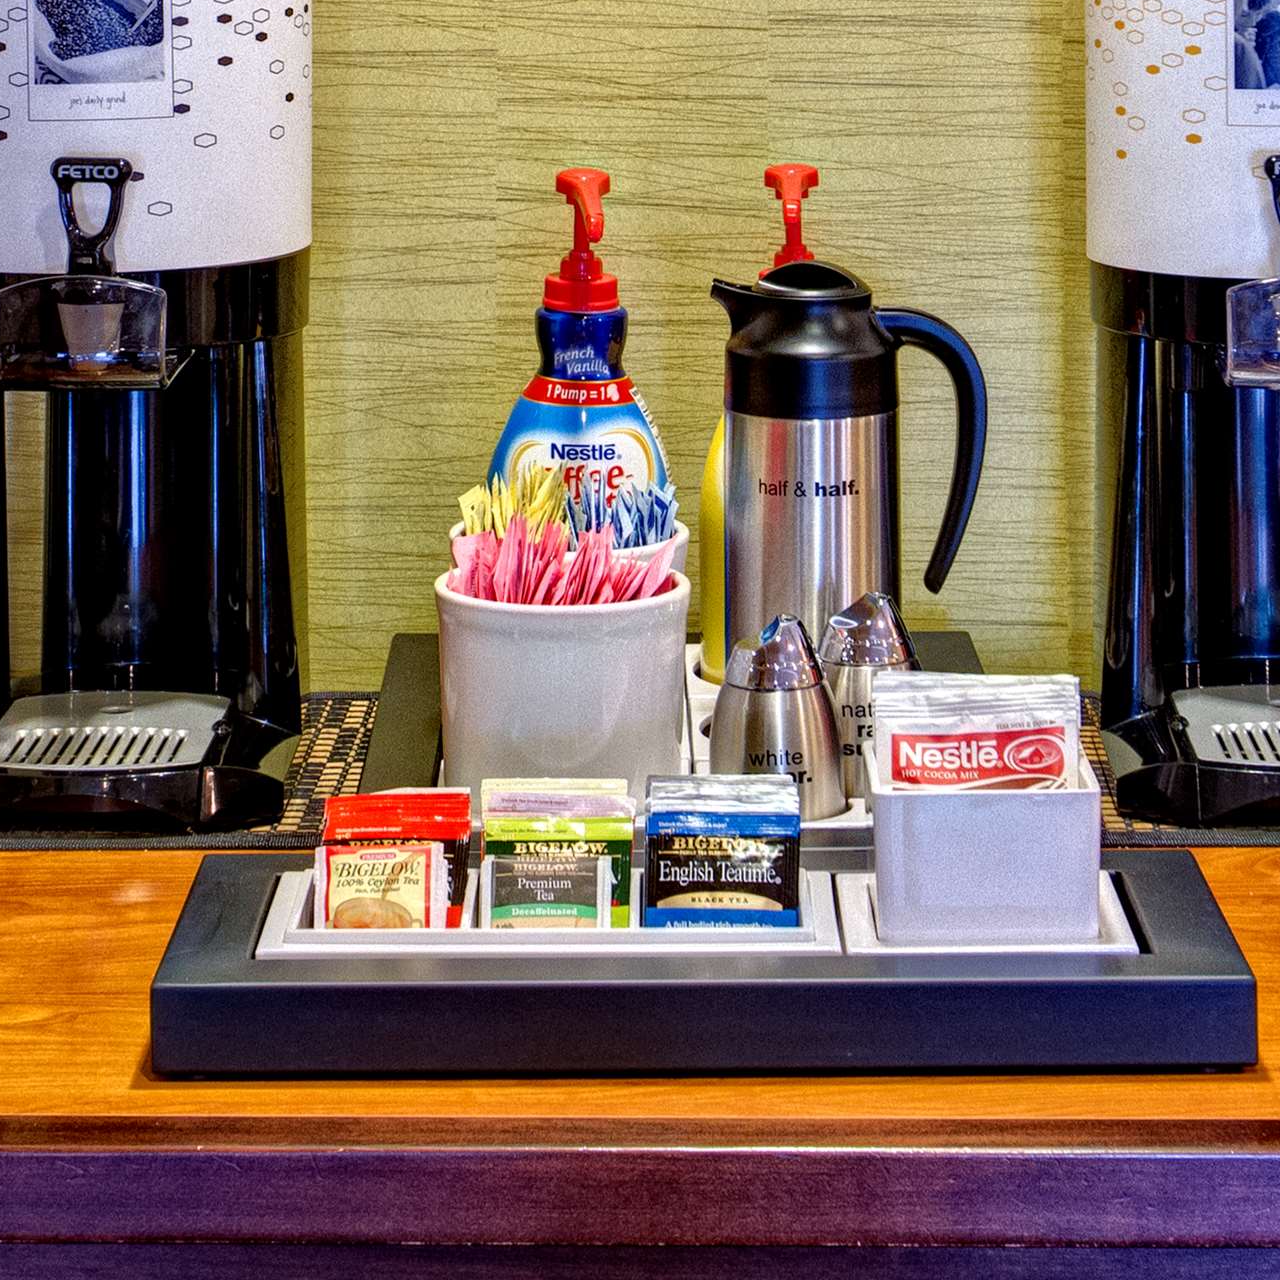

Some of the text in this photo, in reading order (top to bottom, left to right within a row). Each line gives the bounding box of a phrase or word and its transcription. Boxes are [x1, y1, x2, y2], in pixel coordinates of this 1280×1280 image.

[57, 164, 119, 180] FETCO
[554, 345, 595, 365] French
[566, 359, 610, 376] Vanilla
[546, 384, 553, 397] 1
[553, 384, 588, 403] Pump
[759, 478, 860, 498] half & half.
[748, 749, 803, 766] white
[902, 770, 980, 781] HOT COCOA MIX
[658, 860, 715, 887] English
[336, 876, 420, 889] 100% Ceylon Tea
[517, 877, 572, 889] Premium
[535, 890, 555, 901] Tea
[511, 907, 578, 916] Decaffeinated
